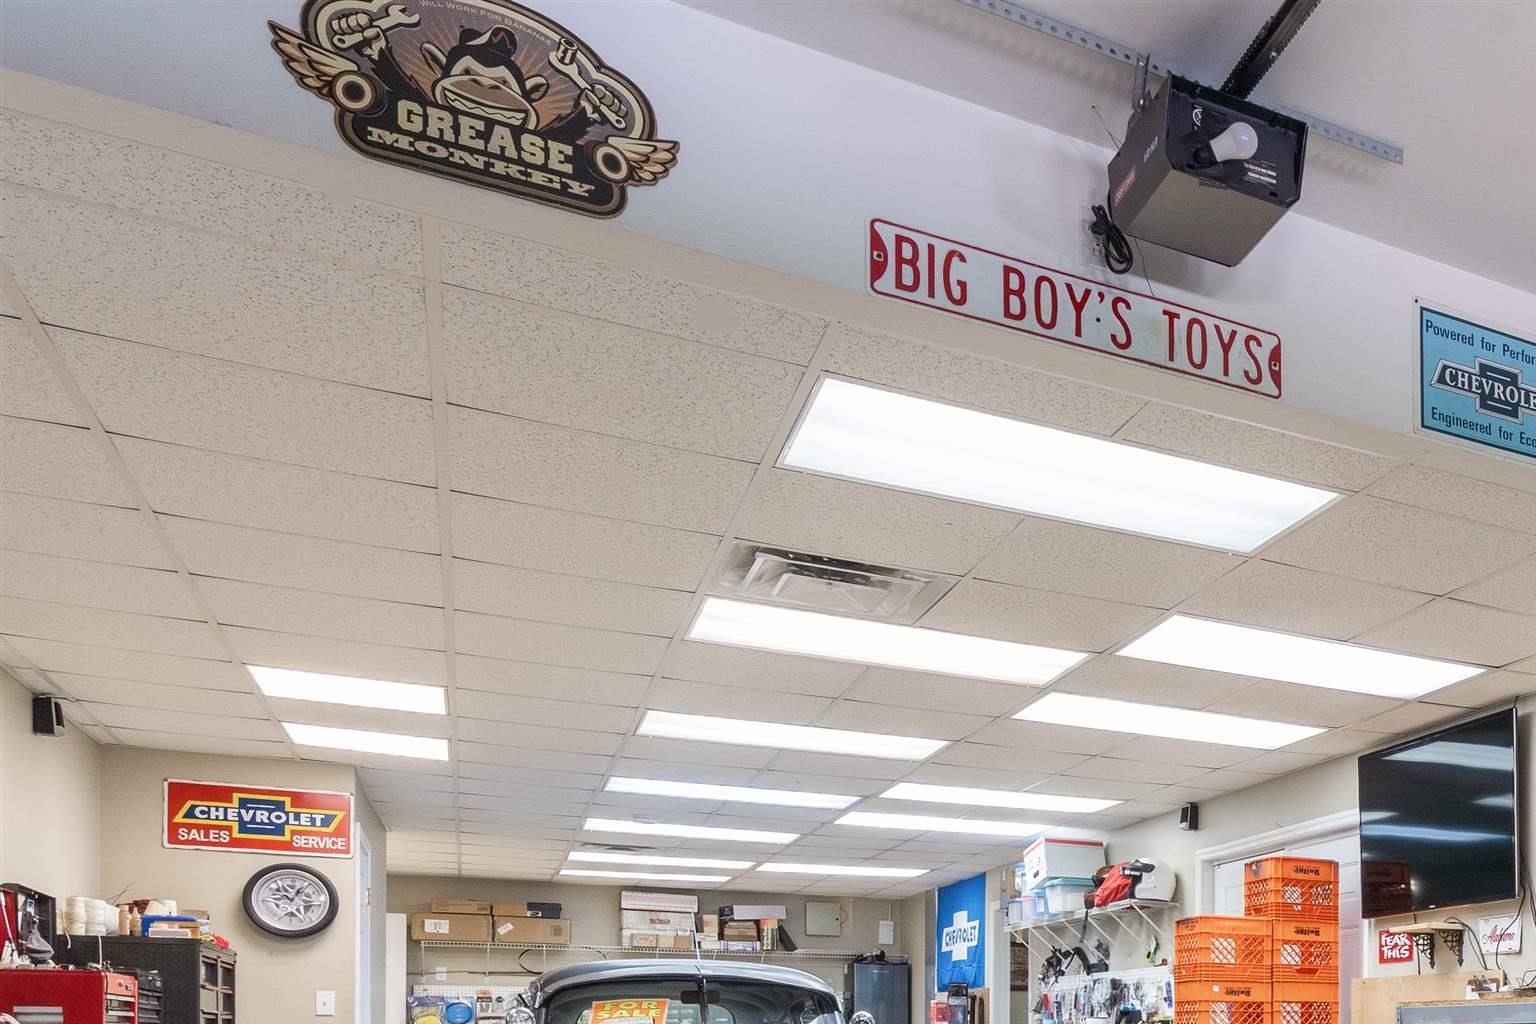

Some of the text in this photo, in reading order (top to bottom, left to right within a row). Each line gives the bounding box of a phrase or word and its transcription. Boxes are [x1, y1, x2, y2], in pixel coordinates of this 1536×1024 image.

[397, 99, 574, 175] GREASE
[366, 126, 596, 197] MONKEY
[895, 233, 1264, 386] BIG BOY'S TOYS
[1425, 318, 1475, 347] Powered
[1481, 337, 1497, 353] for
[1431, 406, 1492, 436] Engineered
[1498, 425, 1514, 442] for
[193, 805, 326, 827] CHEVROLET
[178, 827, 347, 850] SALES SERVICE
[944, 925, 977, 947] CHEVROLET
[1381, 933, 1409, 946] FEAR
[1381, 945, 1410, 960] THIS
[595, 1008, 662, 1020] SALE
[603, 1000, 658, 1011] FOR
